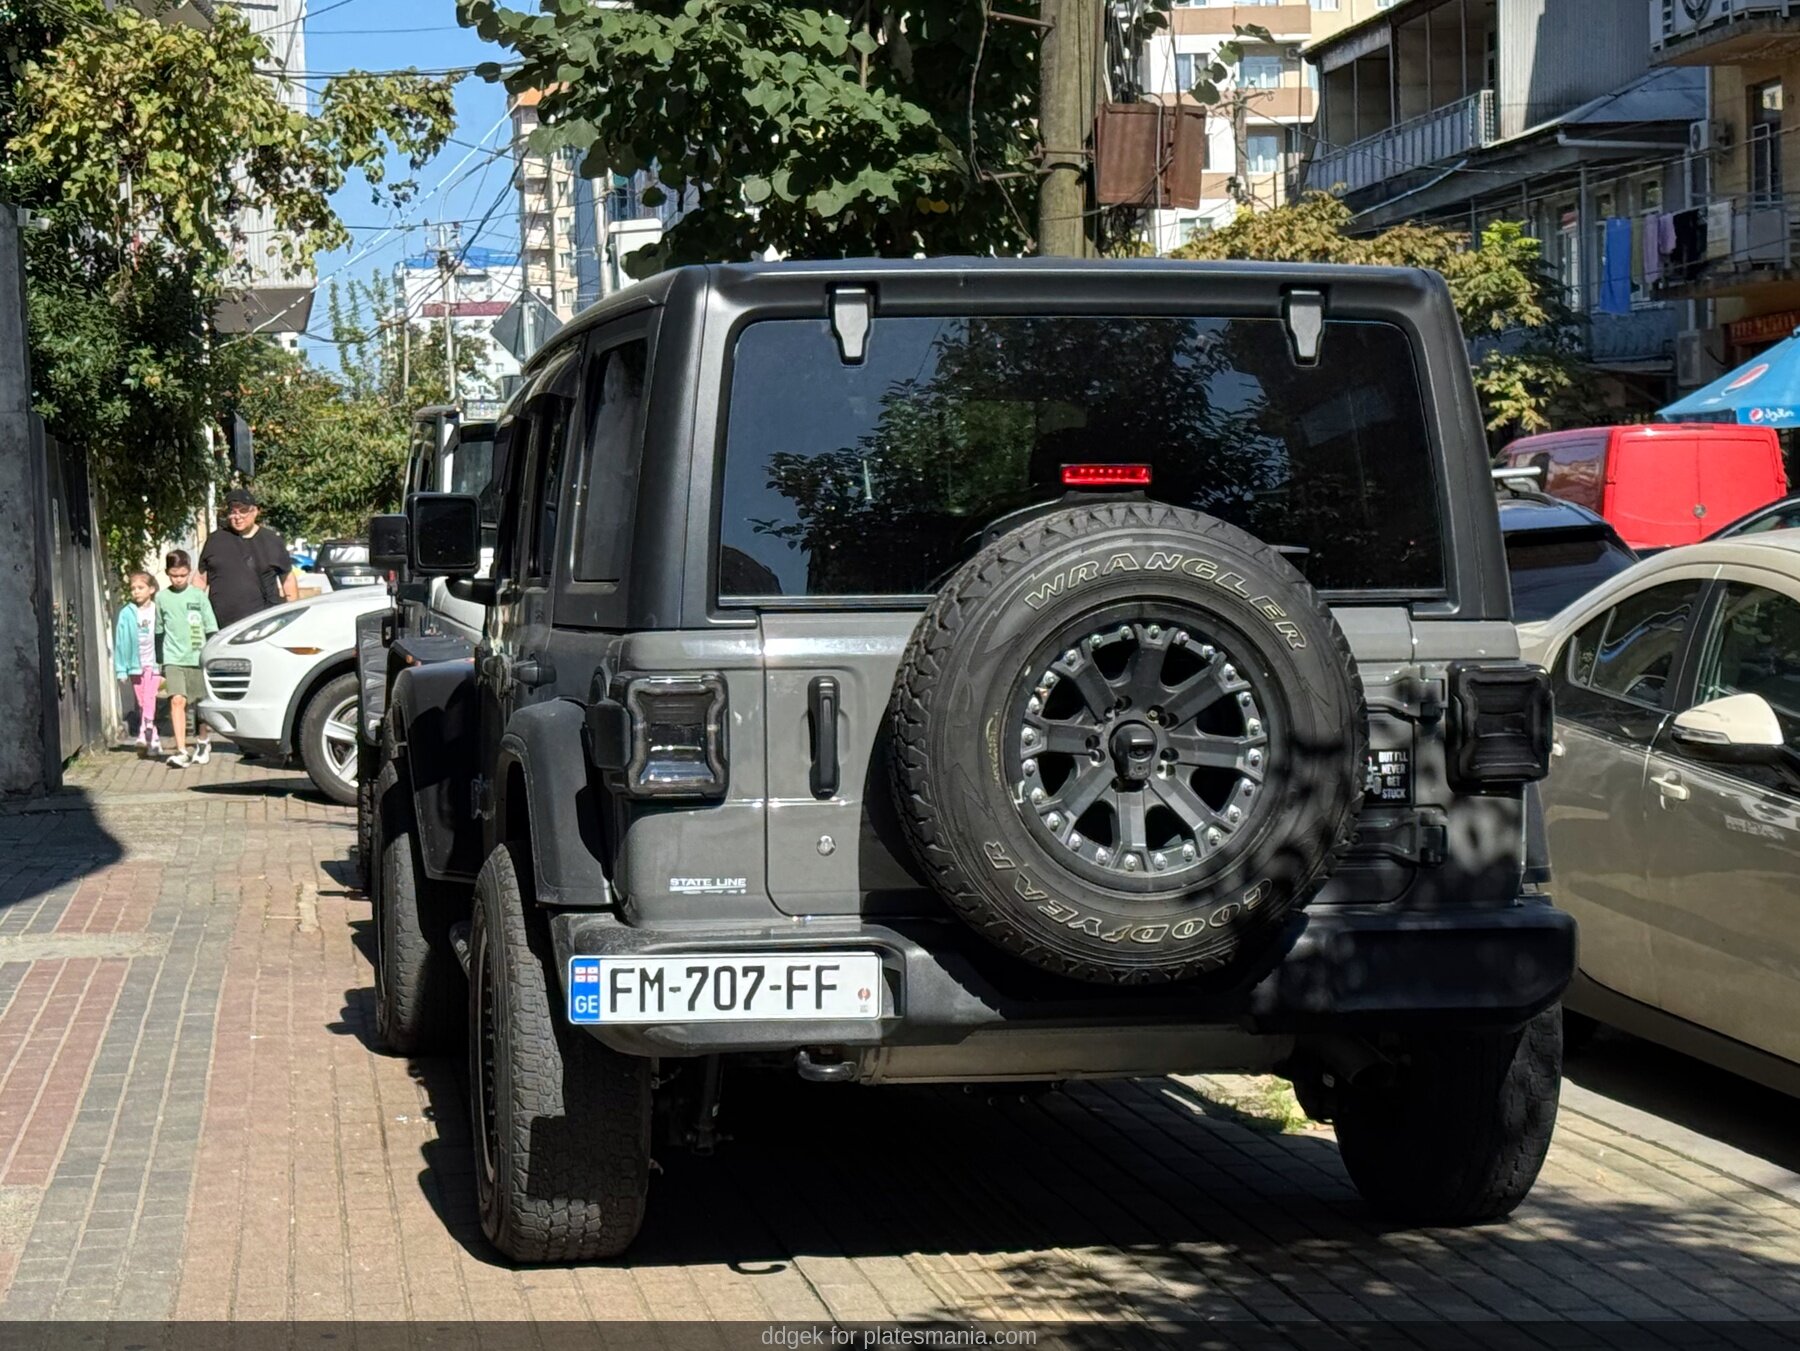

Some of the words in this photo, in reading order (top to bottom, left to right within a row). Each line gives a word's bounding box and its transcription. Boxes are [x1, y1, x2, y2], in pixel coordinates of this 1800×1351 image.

[1024, 552, 1307, 650] WRANGLER
[1379, 752, 1394, 763] BUT
[1381, 764, 1406, 774] NEVER
[1386, 776, 1401, 786] GET
[1382, 788, 1406, 799] STUCK
[670, 877, 712, 887] STATE
[716, 877, 747, 887] LINE
[983, 841, 1273, 943] GOODYEAR
[609, 964, 840, 1013] FM-707-FF
[574, 995, 598, 1014] GE
